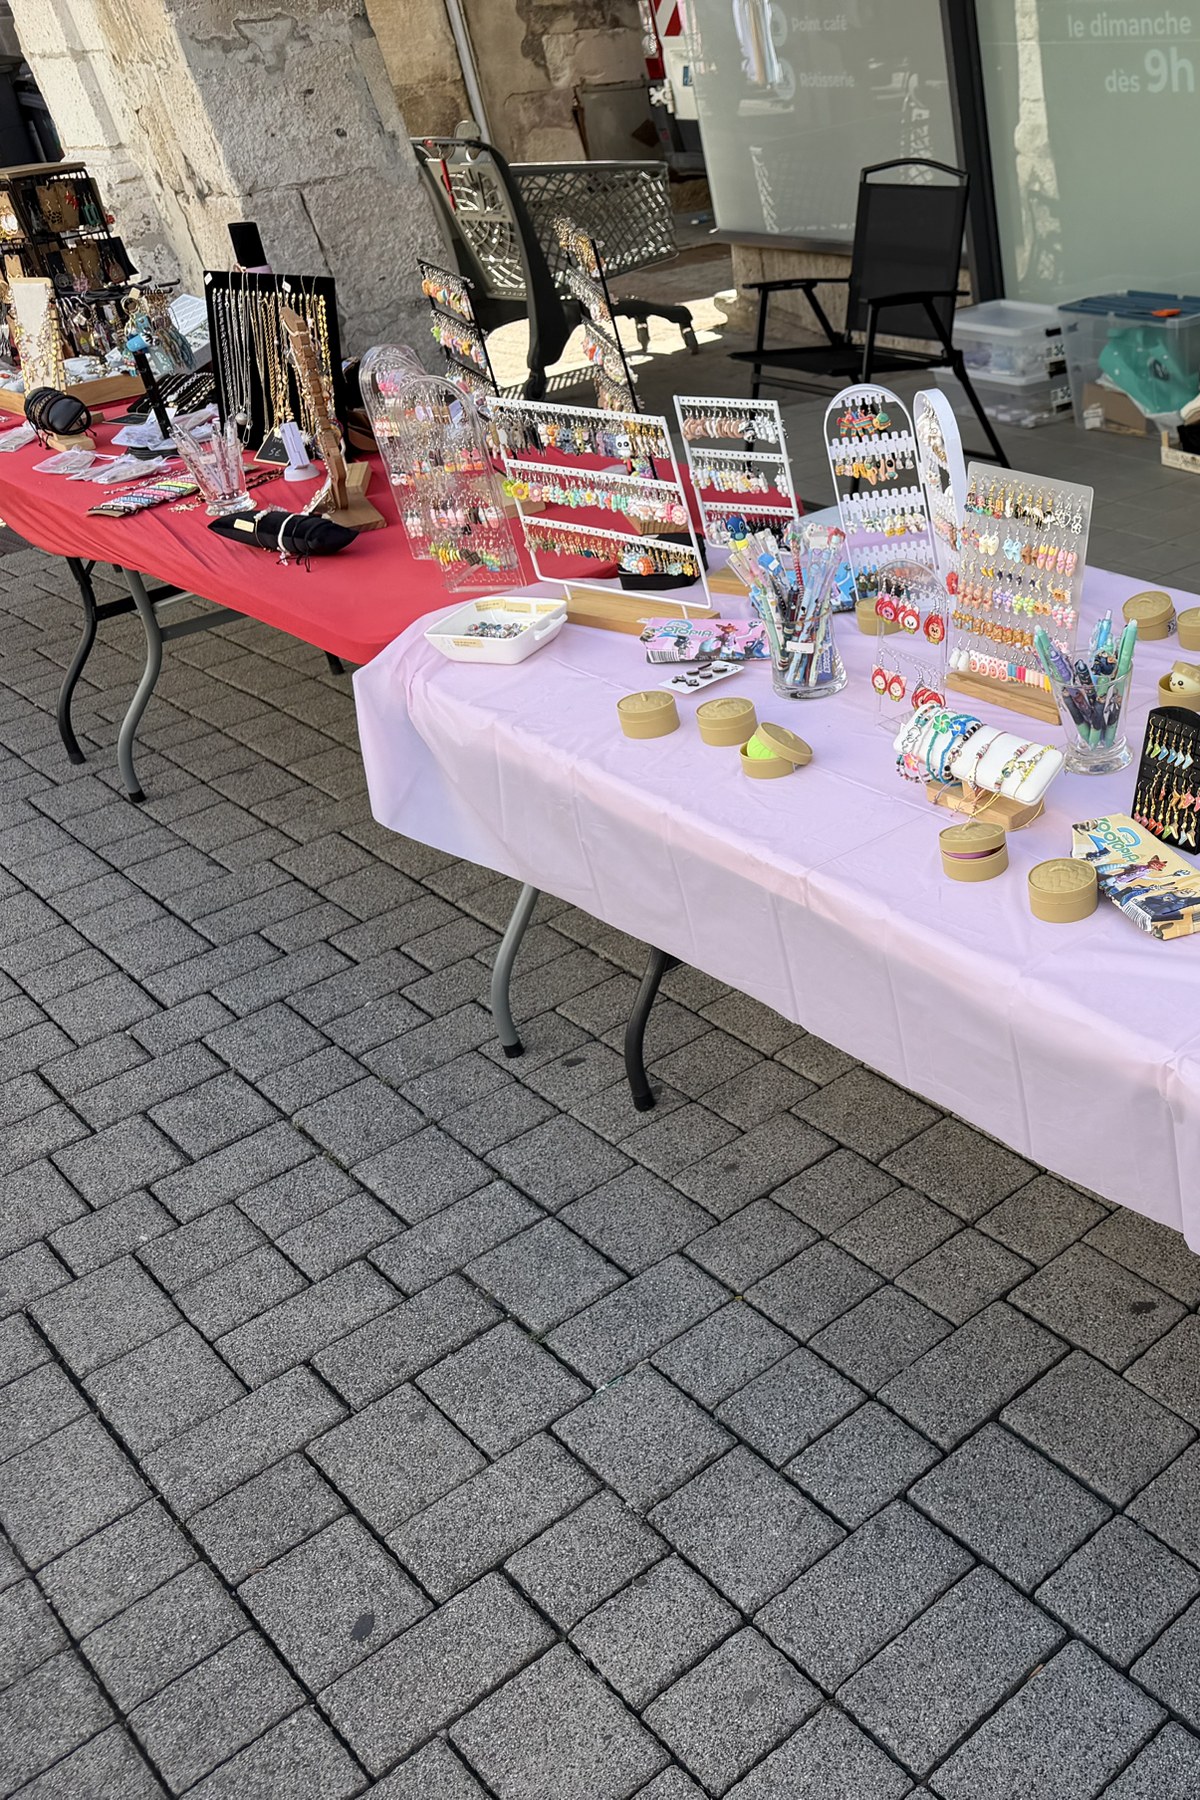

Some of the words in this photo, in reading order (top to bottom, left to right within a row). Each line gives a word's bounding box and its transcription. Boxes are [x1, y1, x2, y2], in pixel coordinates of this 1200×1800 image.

[791, 15, 822, 32] Point
[823, 13, 849, 31] café
[1067, 13, 1084, 38] le
[1090, 10, 1192, 37] dimanche
[800, 70, 856, 89] Rôtisserie
[1105, 68, 1141, 93] dès
[1144, 46, 1195, 93] 9h
